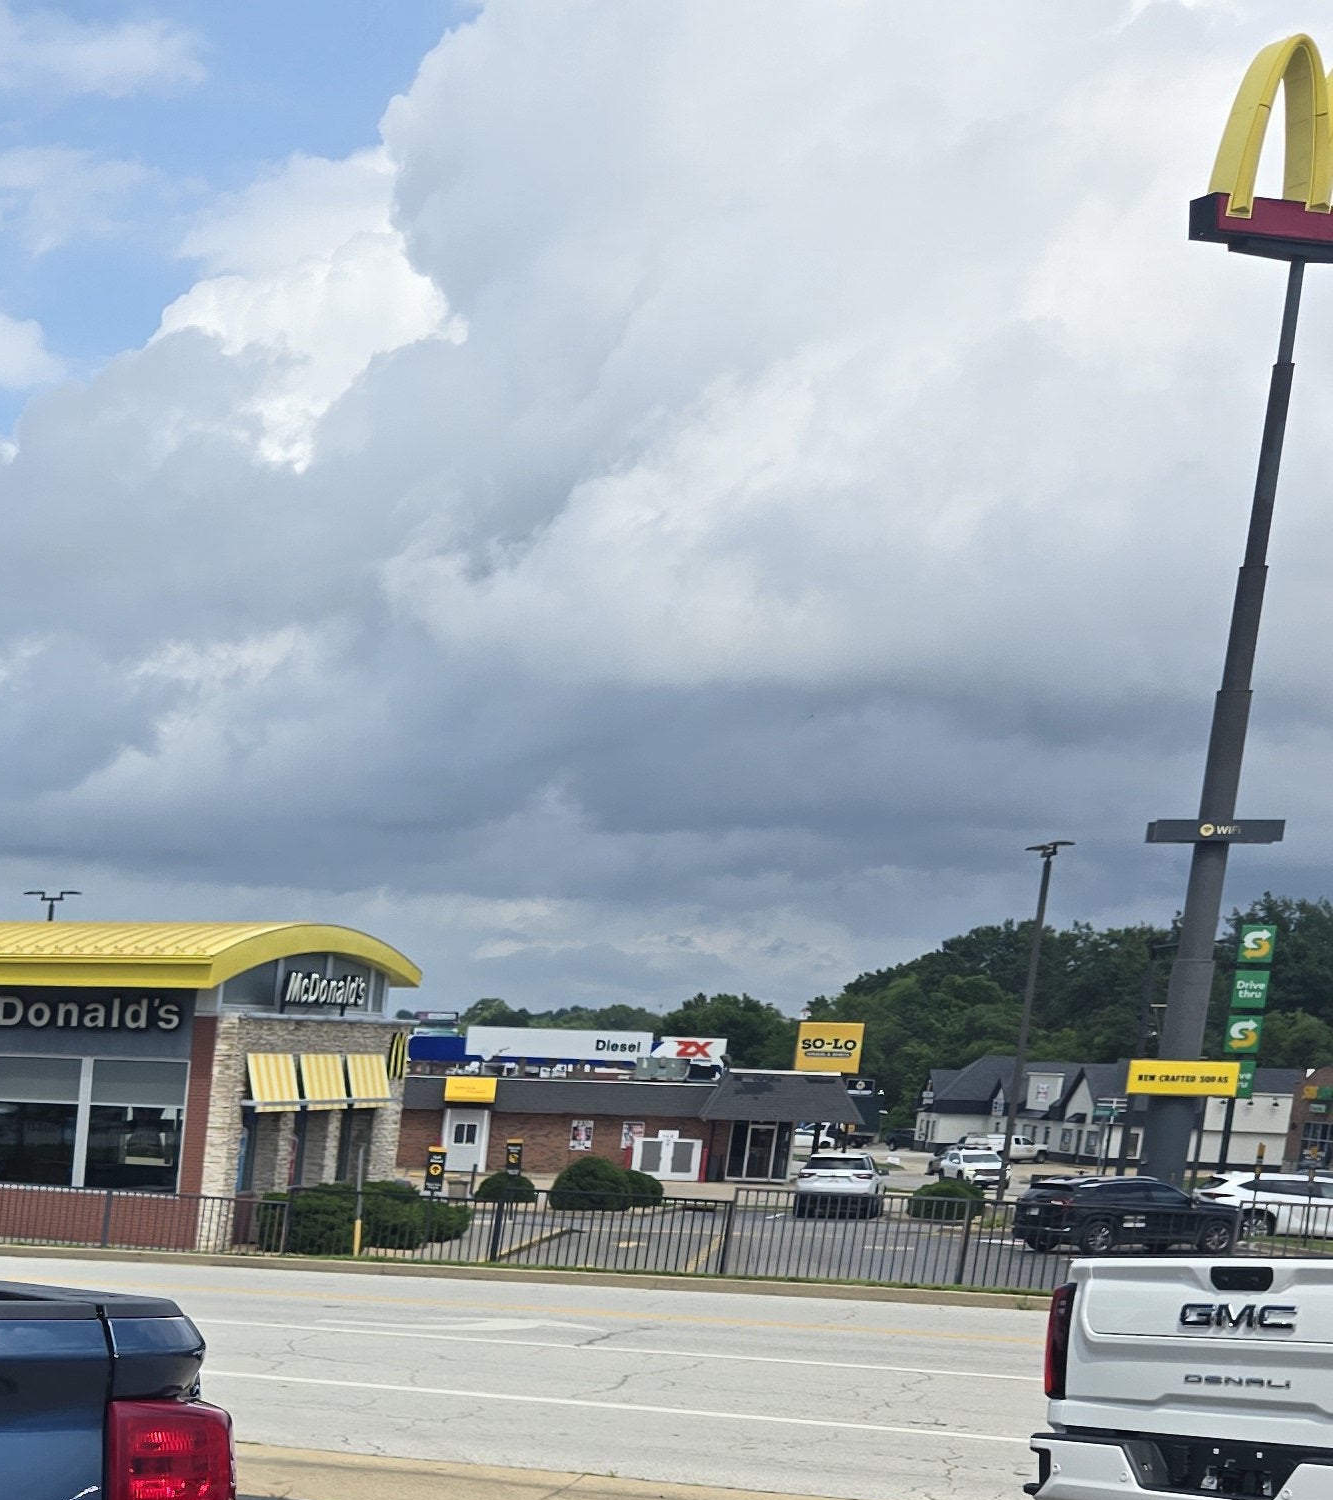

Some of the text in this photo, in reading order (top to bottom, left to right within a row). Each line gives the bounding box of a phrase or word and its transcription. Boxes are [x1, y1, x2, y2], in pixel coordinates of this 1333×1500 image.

[285, 972, 366, 1005] McDonald's
[1236, 981, 1266, 990] Drive
[1238, 990, 1262, 999] thru
[595, 1039, 641, 1053] Diesel
[801, 1038, 857, 1051] SO-LO
[1159, 1074, 1196, 1083] CRAFTED
[1199, 1075, 1229, 1084] SODAS
[1179, 1303, 1297, 1329] GMC
[1184, 1374, 1291, 1389] DENALI
